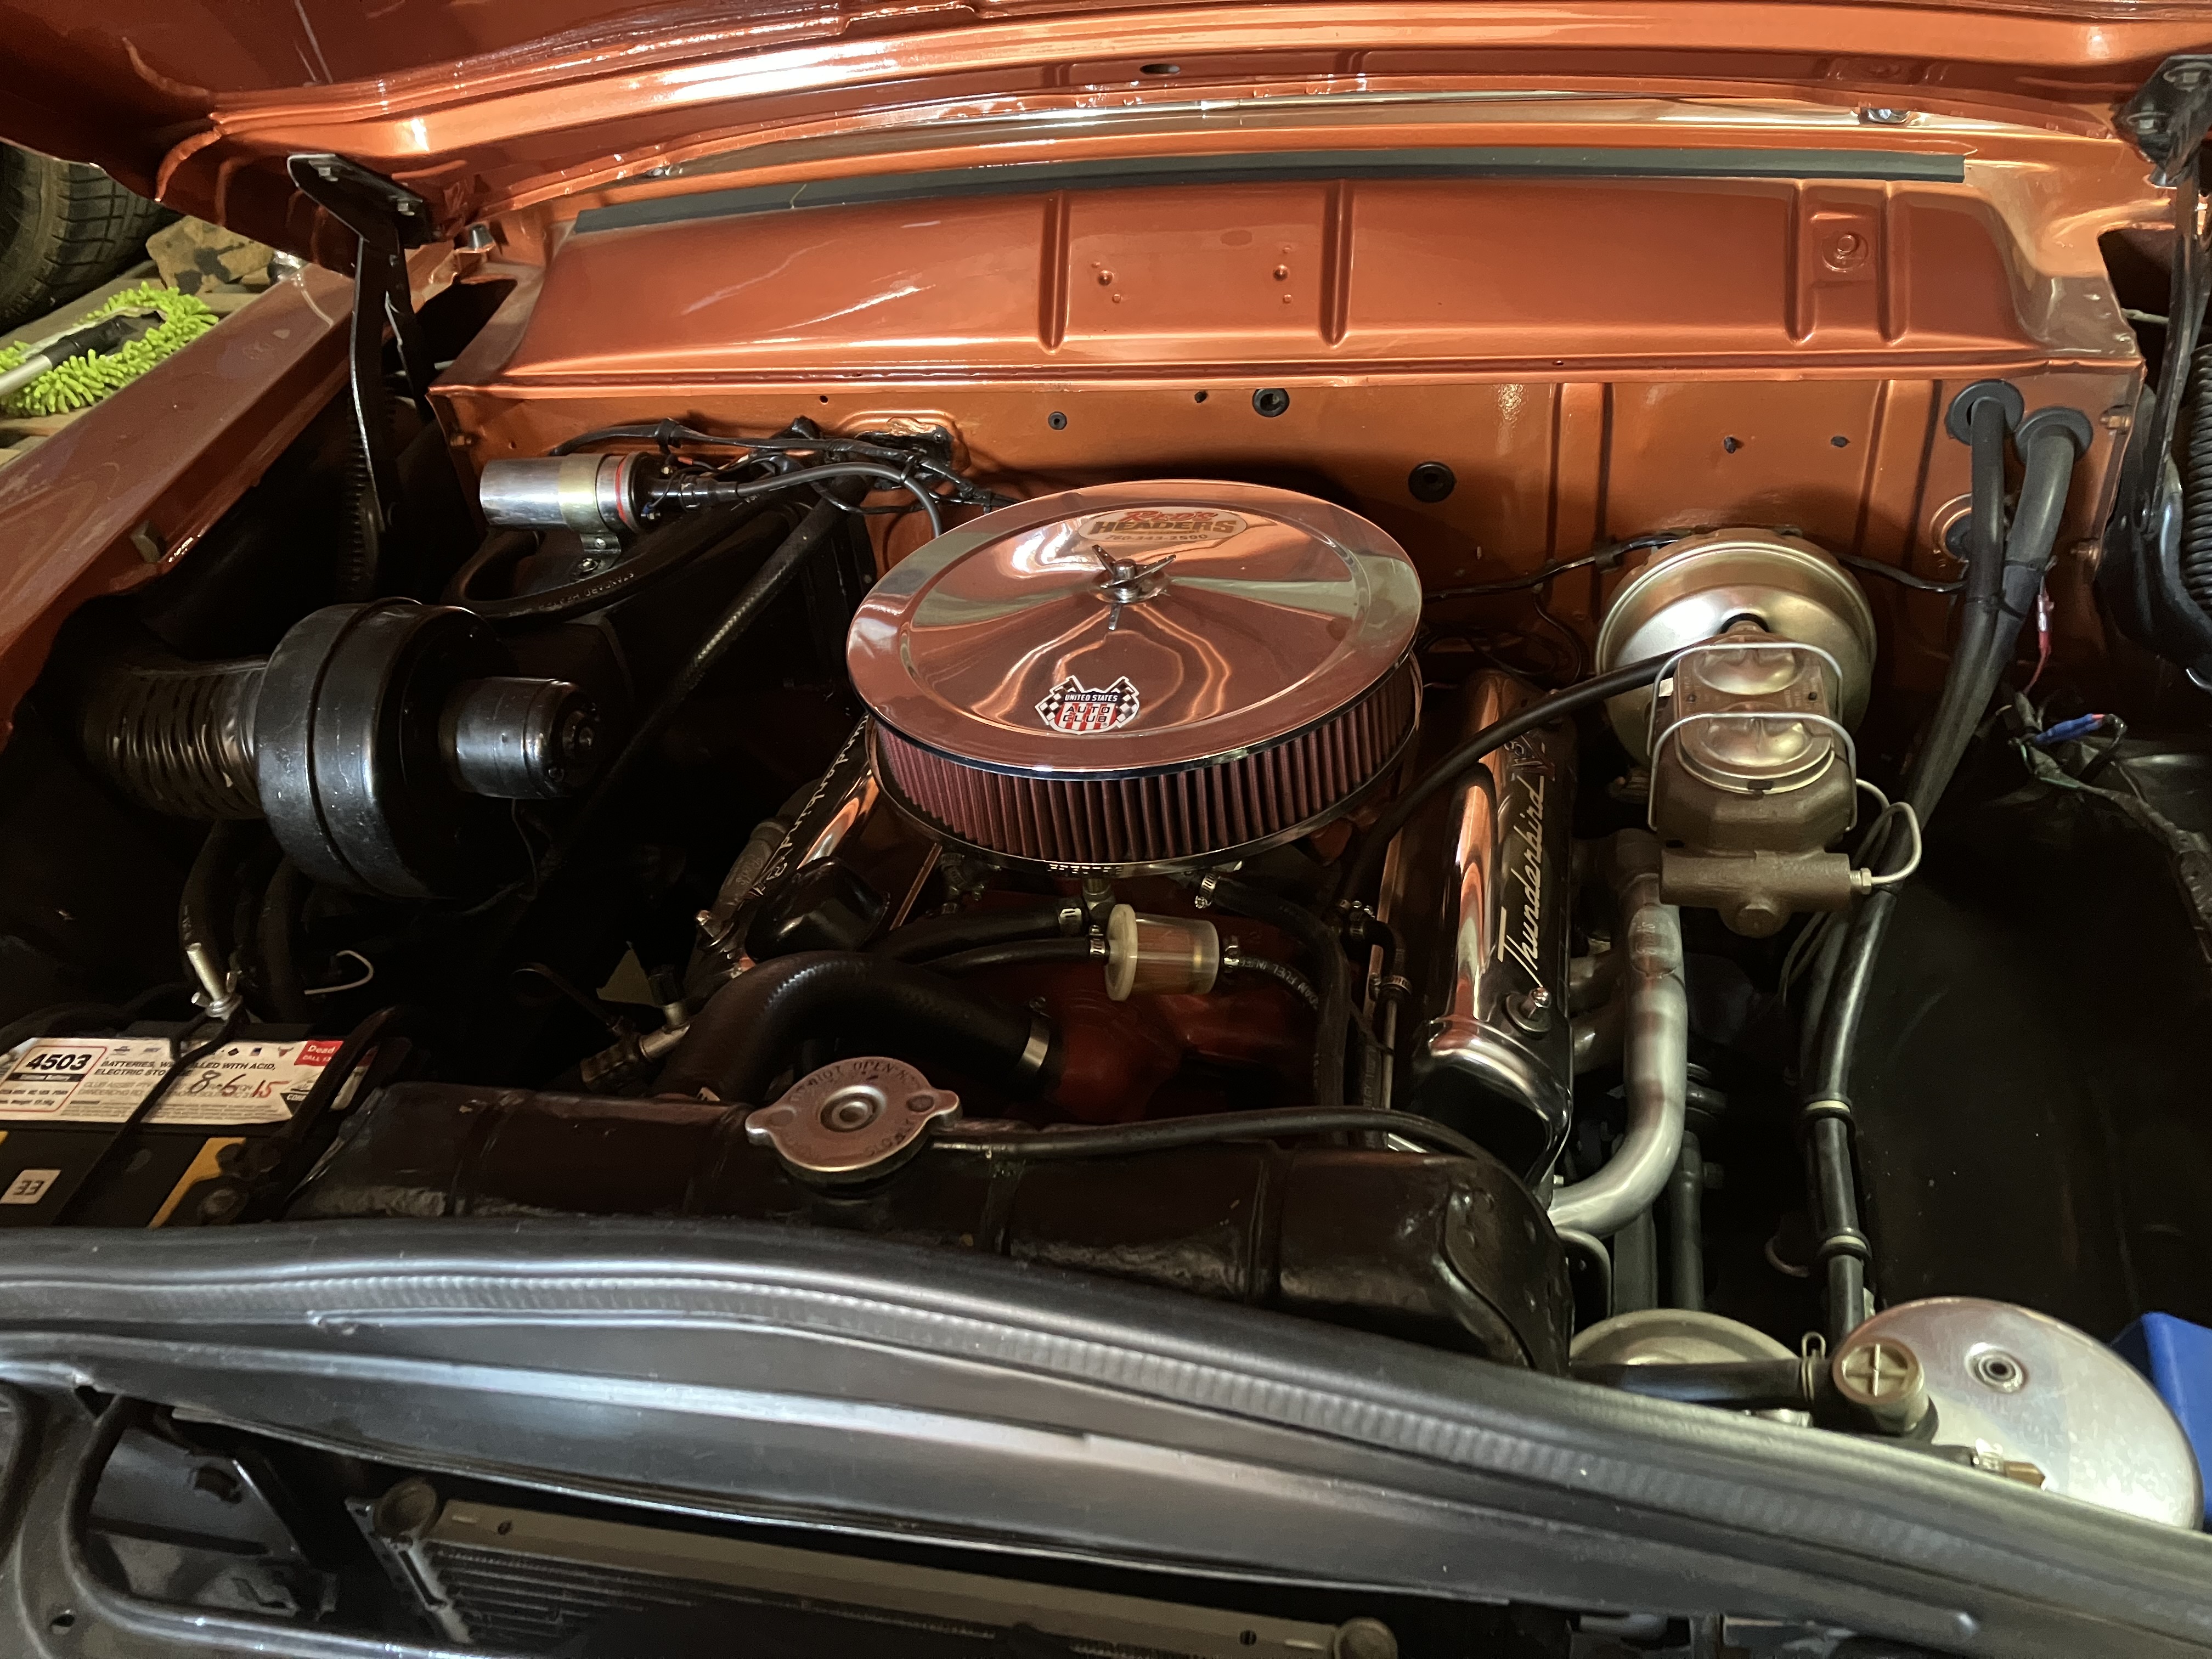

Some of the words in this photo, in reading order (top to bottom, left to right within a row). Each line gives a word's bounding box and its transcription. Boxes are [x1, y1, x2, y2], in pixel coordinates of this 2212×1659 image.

[1088, 520, 1237, 535] HEADERS
[1064, 693, 1090, 702] UNITED
[1065, 706, 1110, 714] AUTO
[1062, 714, 1107, 723] CLUB
[1497, 774, 1544, 988] Thunderbird
[1273, 963, 1298, 985] FUEL
[307, 1045, 336, 1054] Dead
[26, 1053, 92, 1070] 4503
[13, 1180, 44, 1195] 33
